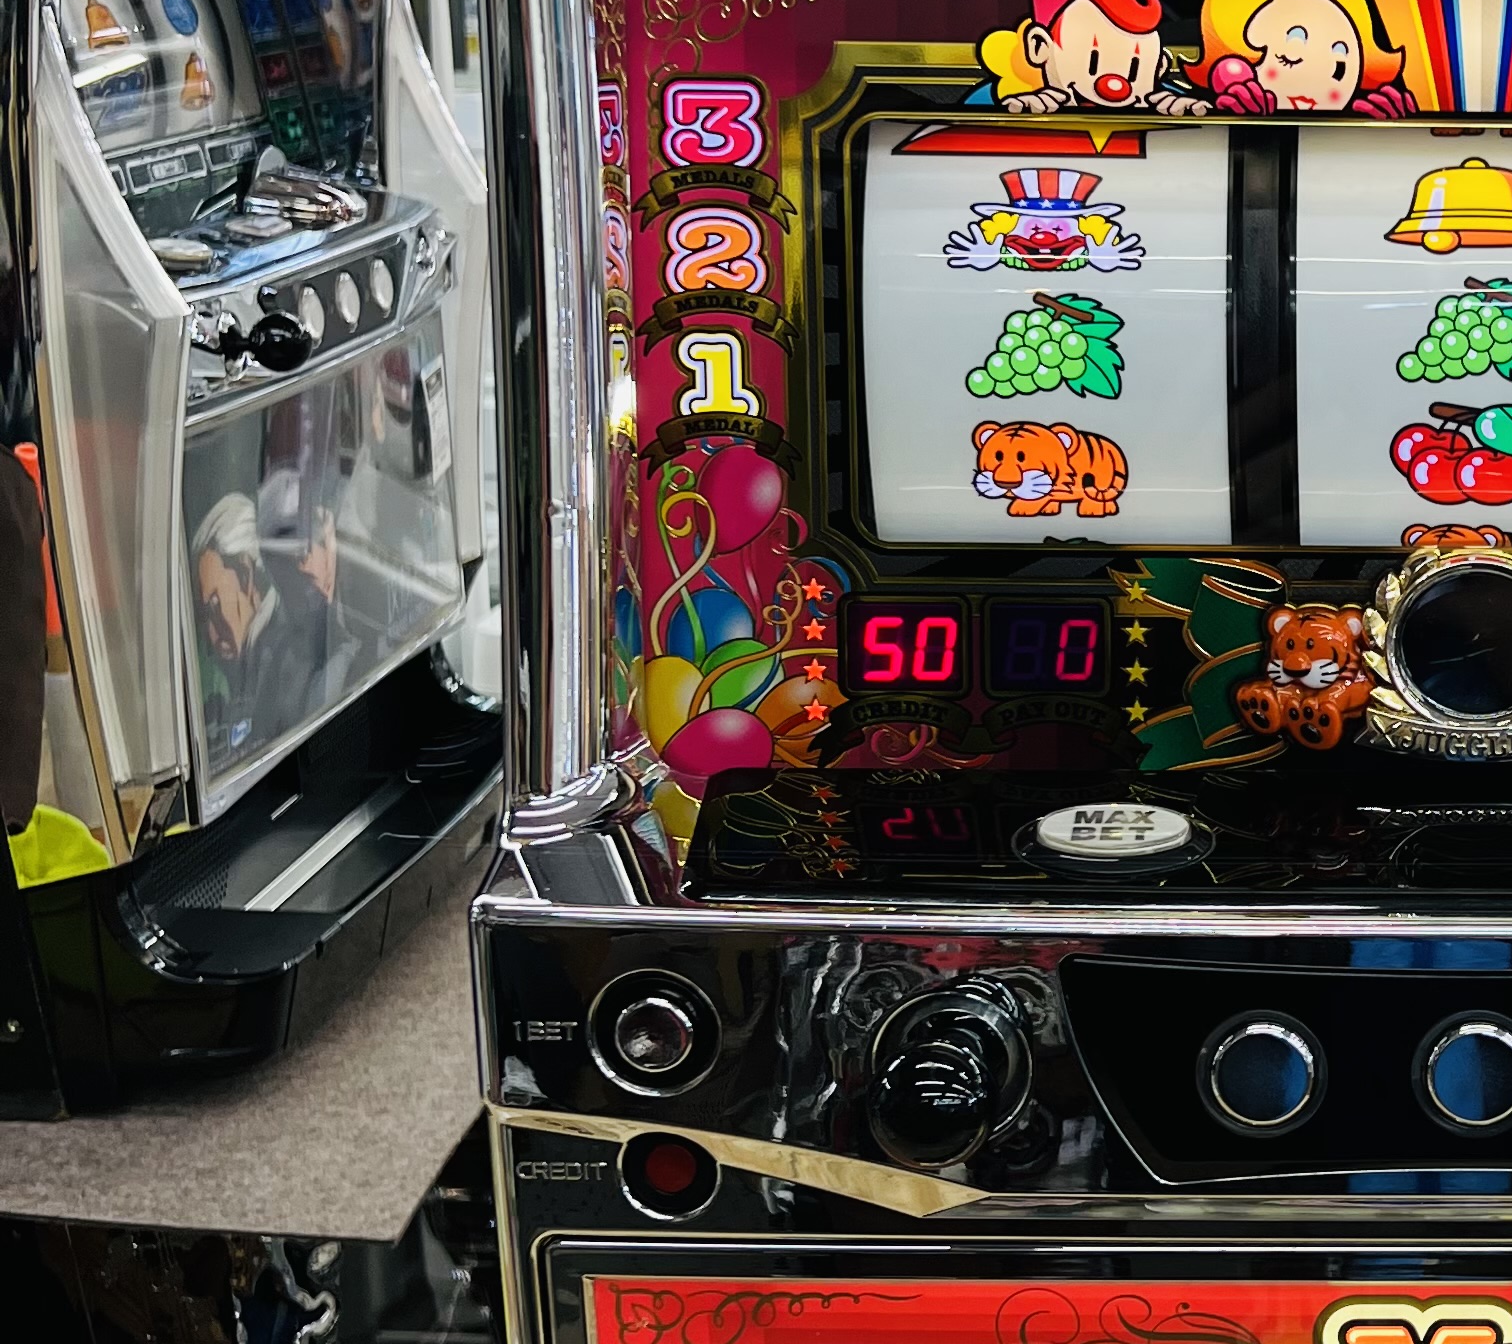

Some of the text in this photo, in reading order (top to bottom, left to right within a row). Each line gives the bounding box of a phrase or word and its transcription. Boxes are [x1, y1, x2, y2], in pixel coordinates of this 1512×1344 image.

[661, 79, 763, 167] 3
[672, 169, 757, 190] MEDALS
[664, 208, 767, 294] 2
[673, 294, 761, 314] MEDALS
[678, 333, 761, 415] 1
[682, 418, 754, 436] MEDAL
[863, 616, 957, 682] 50
[1055, 619, 1098, 682] 0
[851, 700, 949, 724] CREDIT
[999, 701, 1108, 725] PAY OUT
[1074, 810, 1156, 825] MAX
[1070, 826, 1155, 841] BET
[512, 1020, 579, 1042] 1 BET
[515, 1160, 608, 1181] CREDIT
